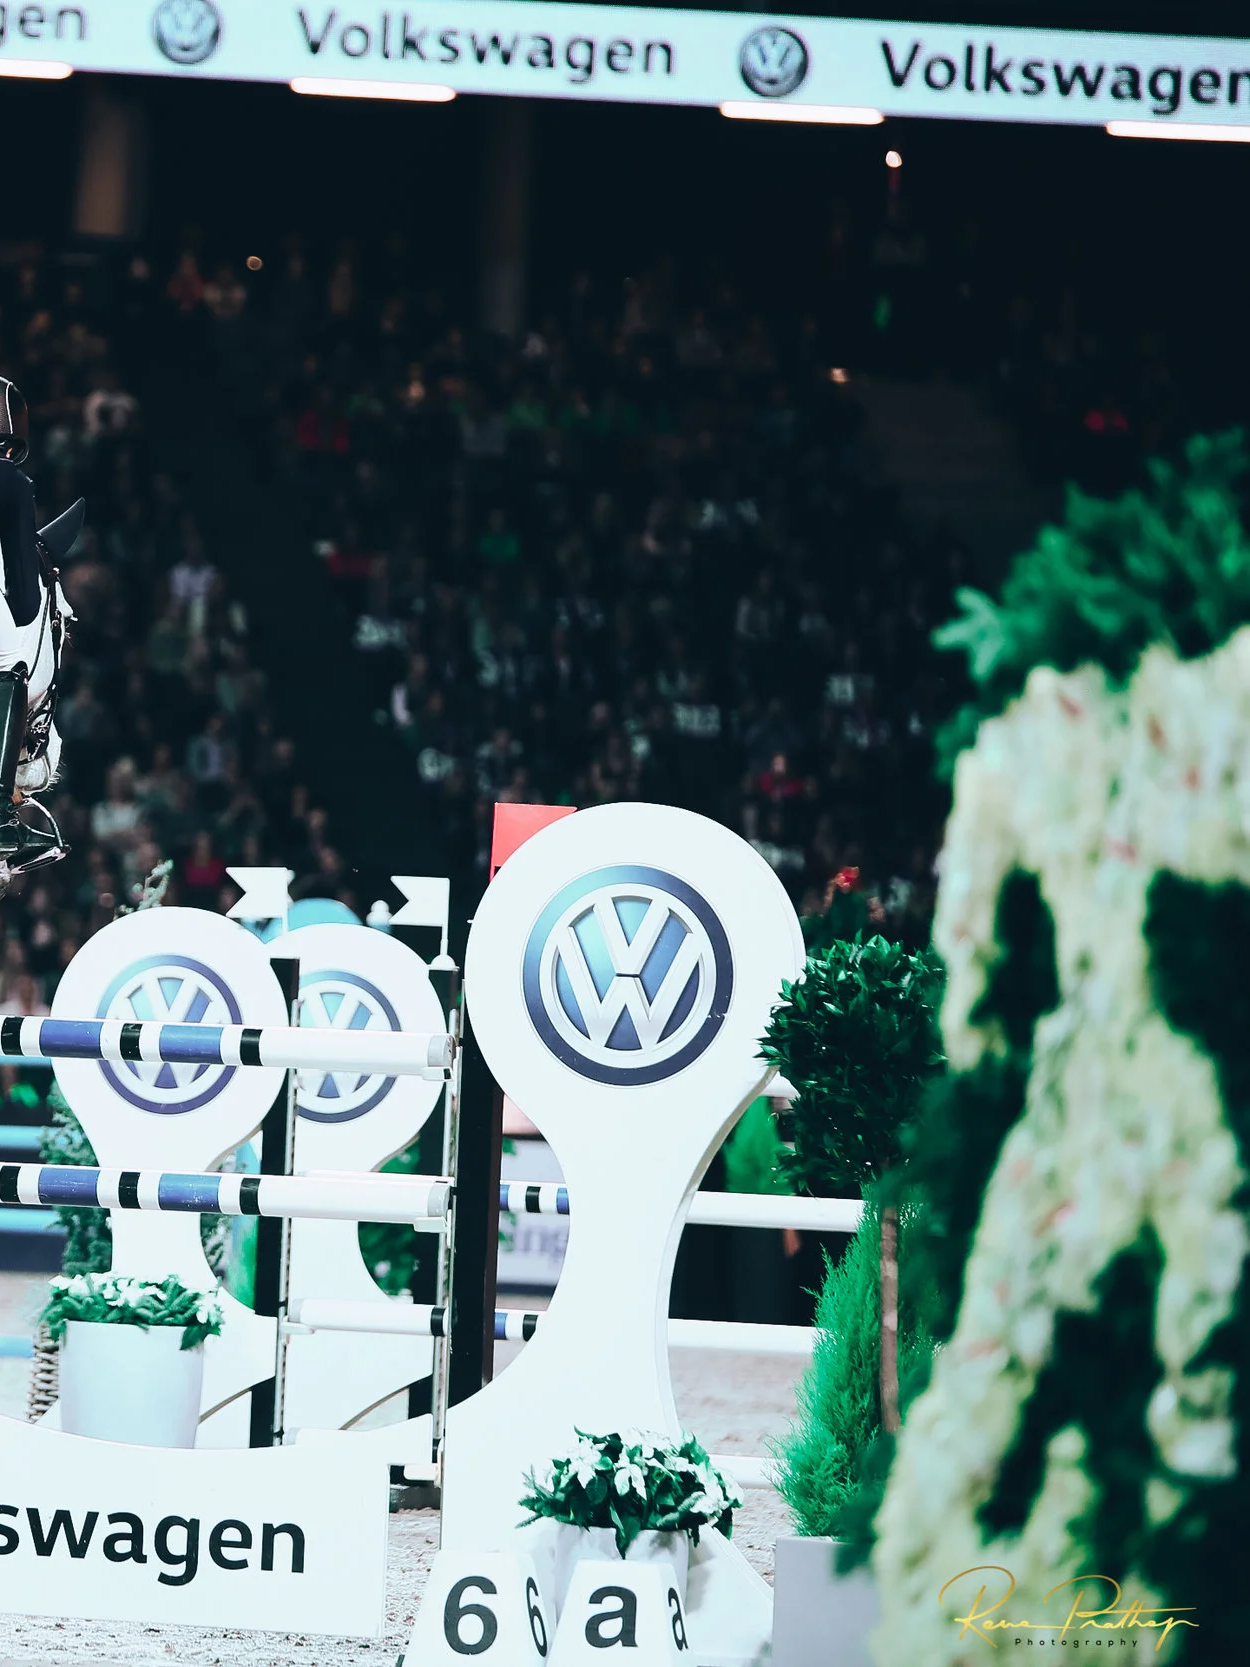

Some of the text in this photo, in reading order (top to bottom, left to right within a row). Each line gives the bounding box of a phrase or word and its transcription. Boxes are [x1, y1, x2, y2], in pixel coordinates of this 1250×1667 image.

[298, 7, 674, 83] Volkswagen
[881, 39, 1250, 115] Volkswagen
[443, 1575, 498, 1656] 6
[525, 1576, 548, 1658] 6
[584, 1585, 639, 1649] a
[667, 1587, 690, 1651] a
